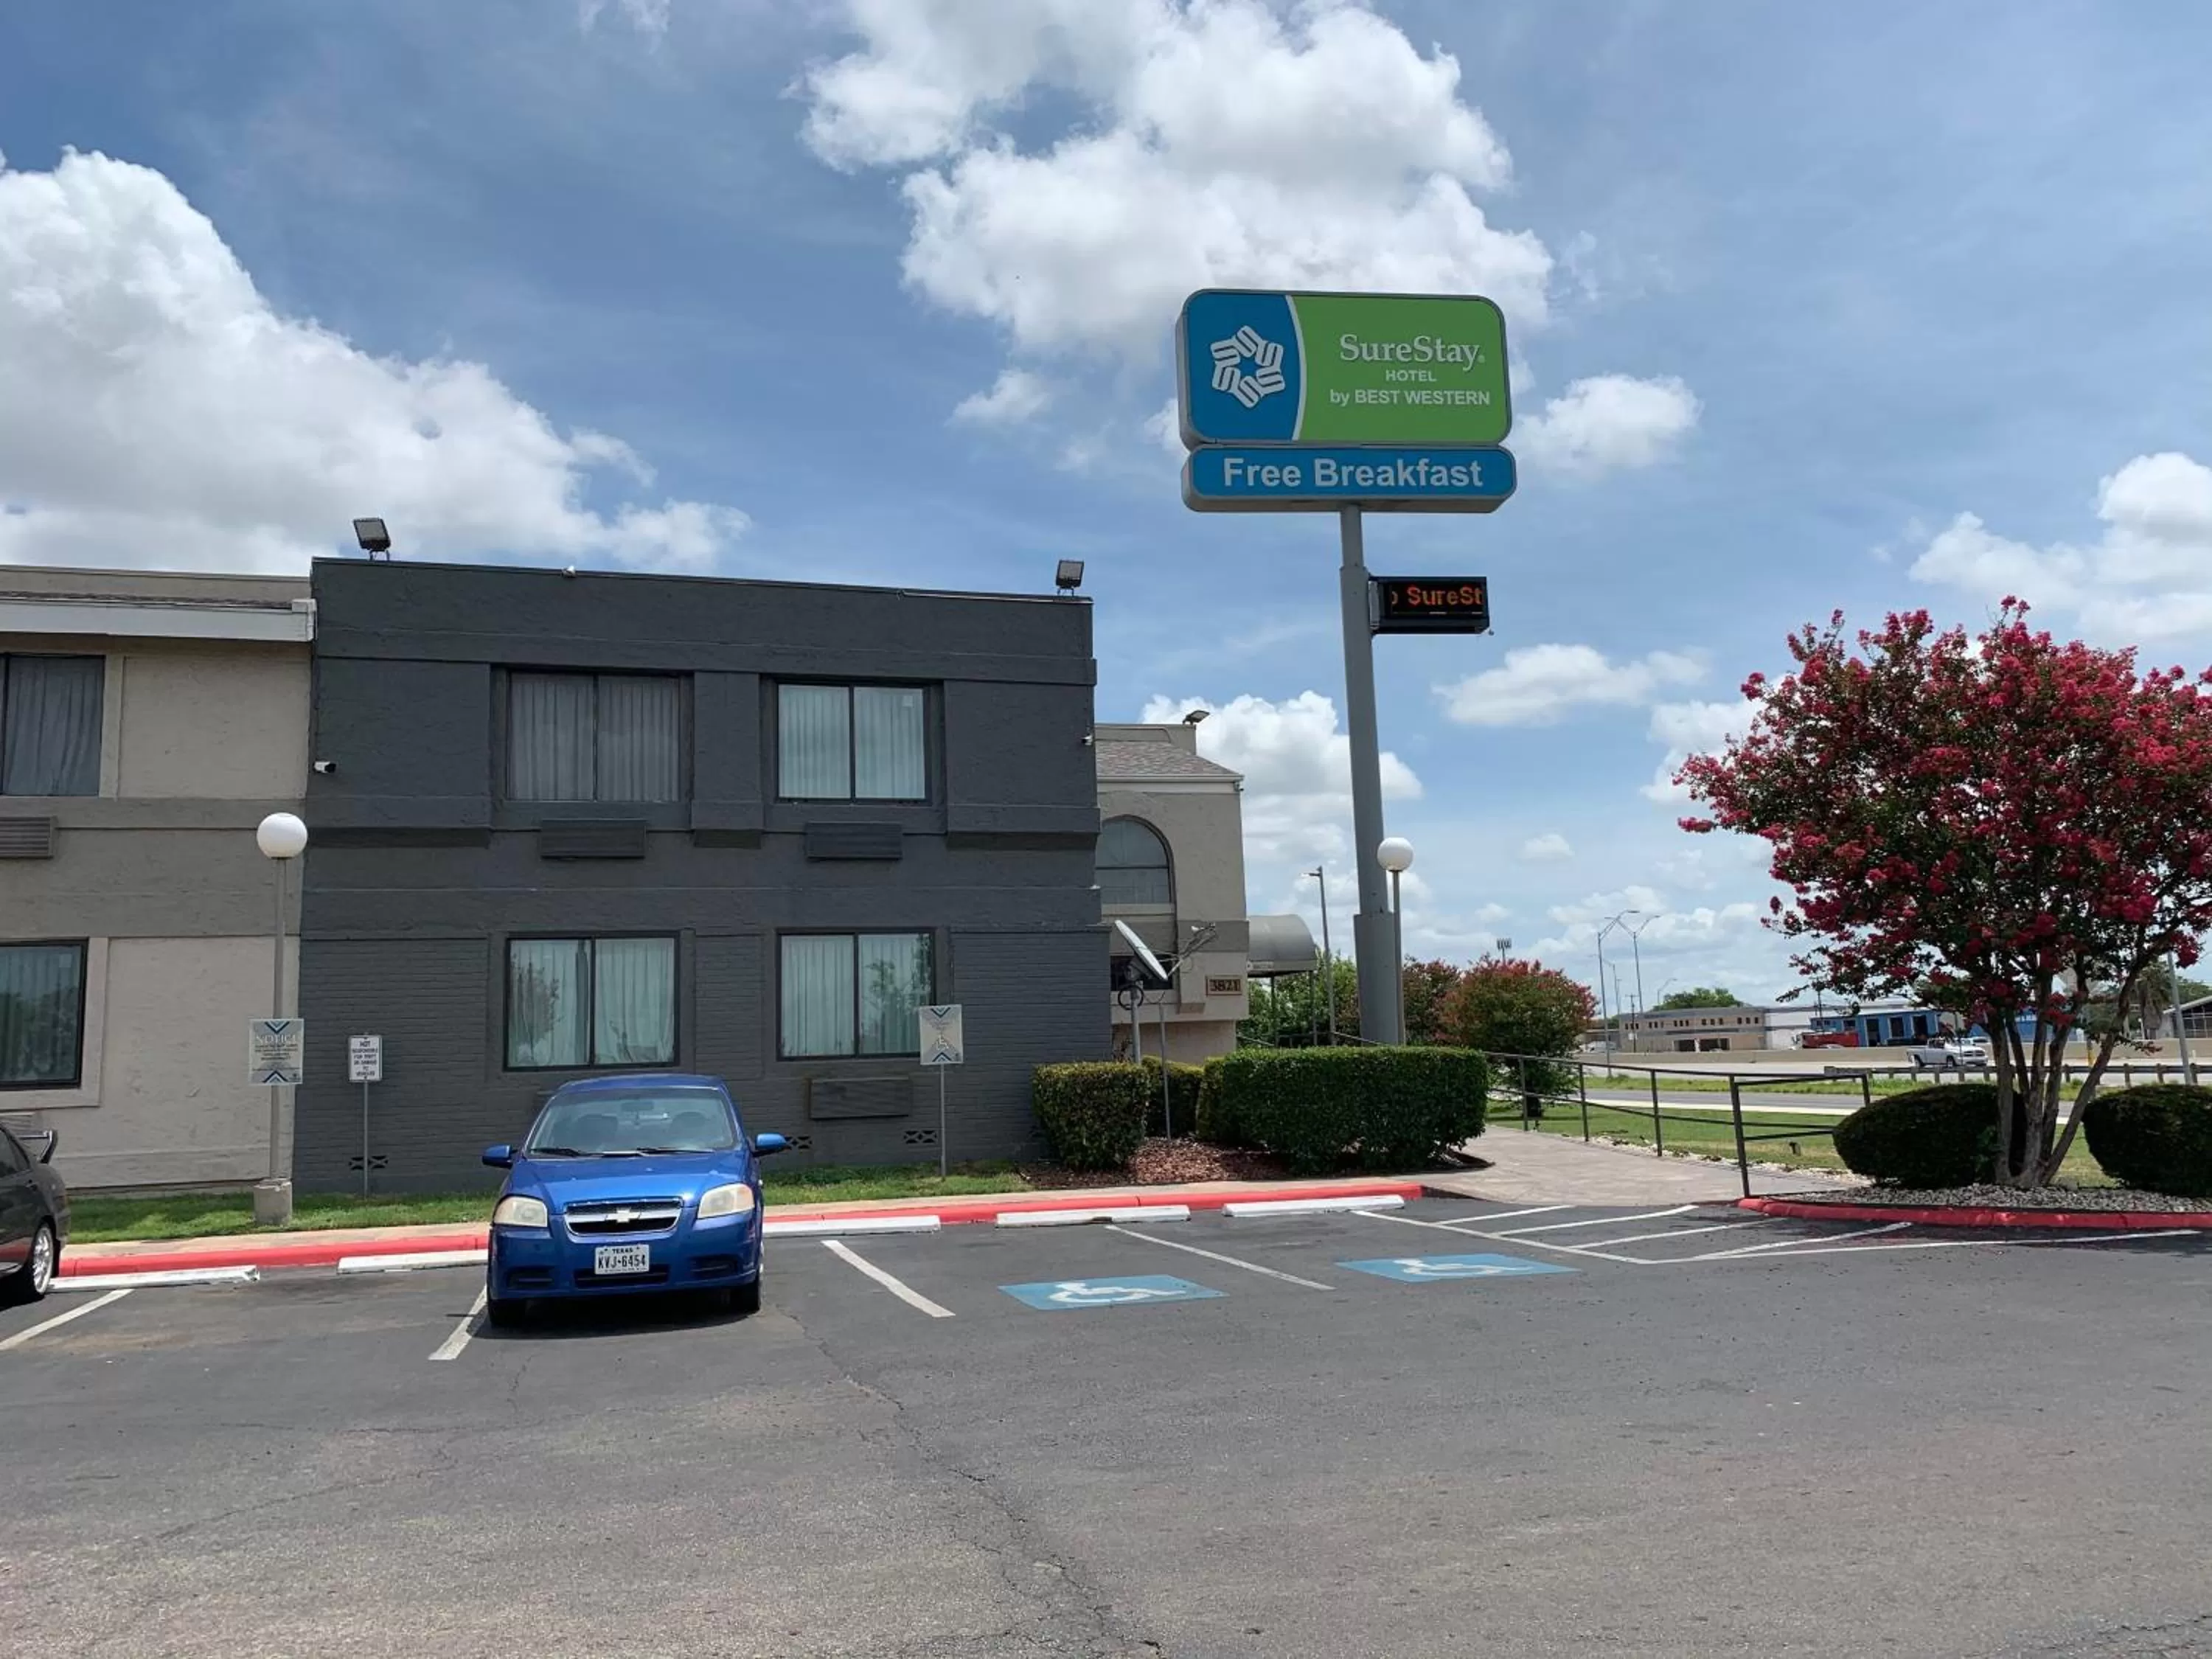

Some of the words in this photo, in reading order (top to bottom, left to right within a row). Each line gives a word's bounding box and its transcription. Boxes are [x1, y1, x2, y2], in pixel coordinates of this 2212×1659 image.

[1340, 334, 1480, 371] SureStay
[1385, 370, 1436, 382] HOTEL
[1329, 389, 1349, 407] by
[1354, 391, 1400, 404] BEST
[1405, 391, 1491, 406] WESTERN
[1223, 457, 1301, 487] Free
[1314, 458, 1483, 487] Breakfast
